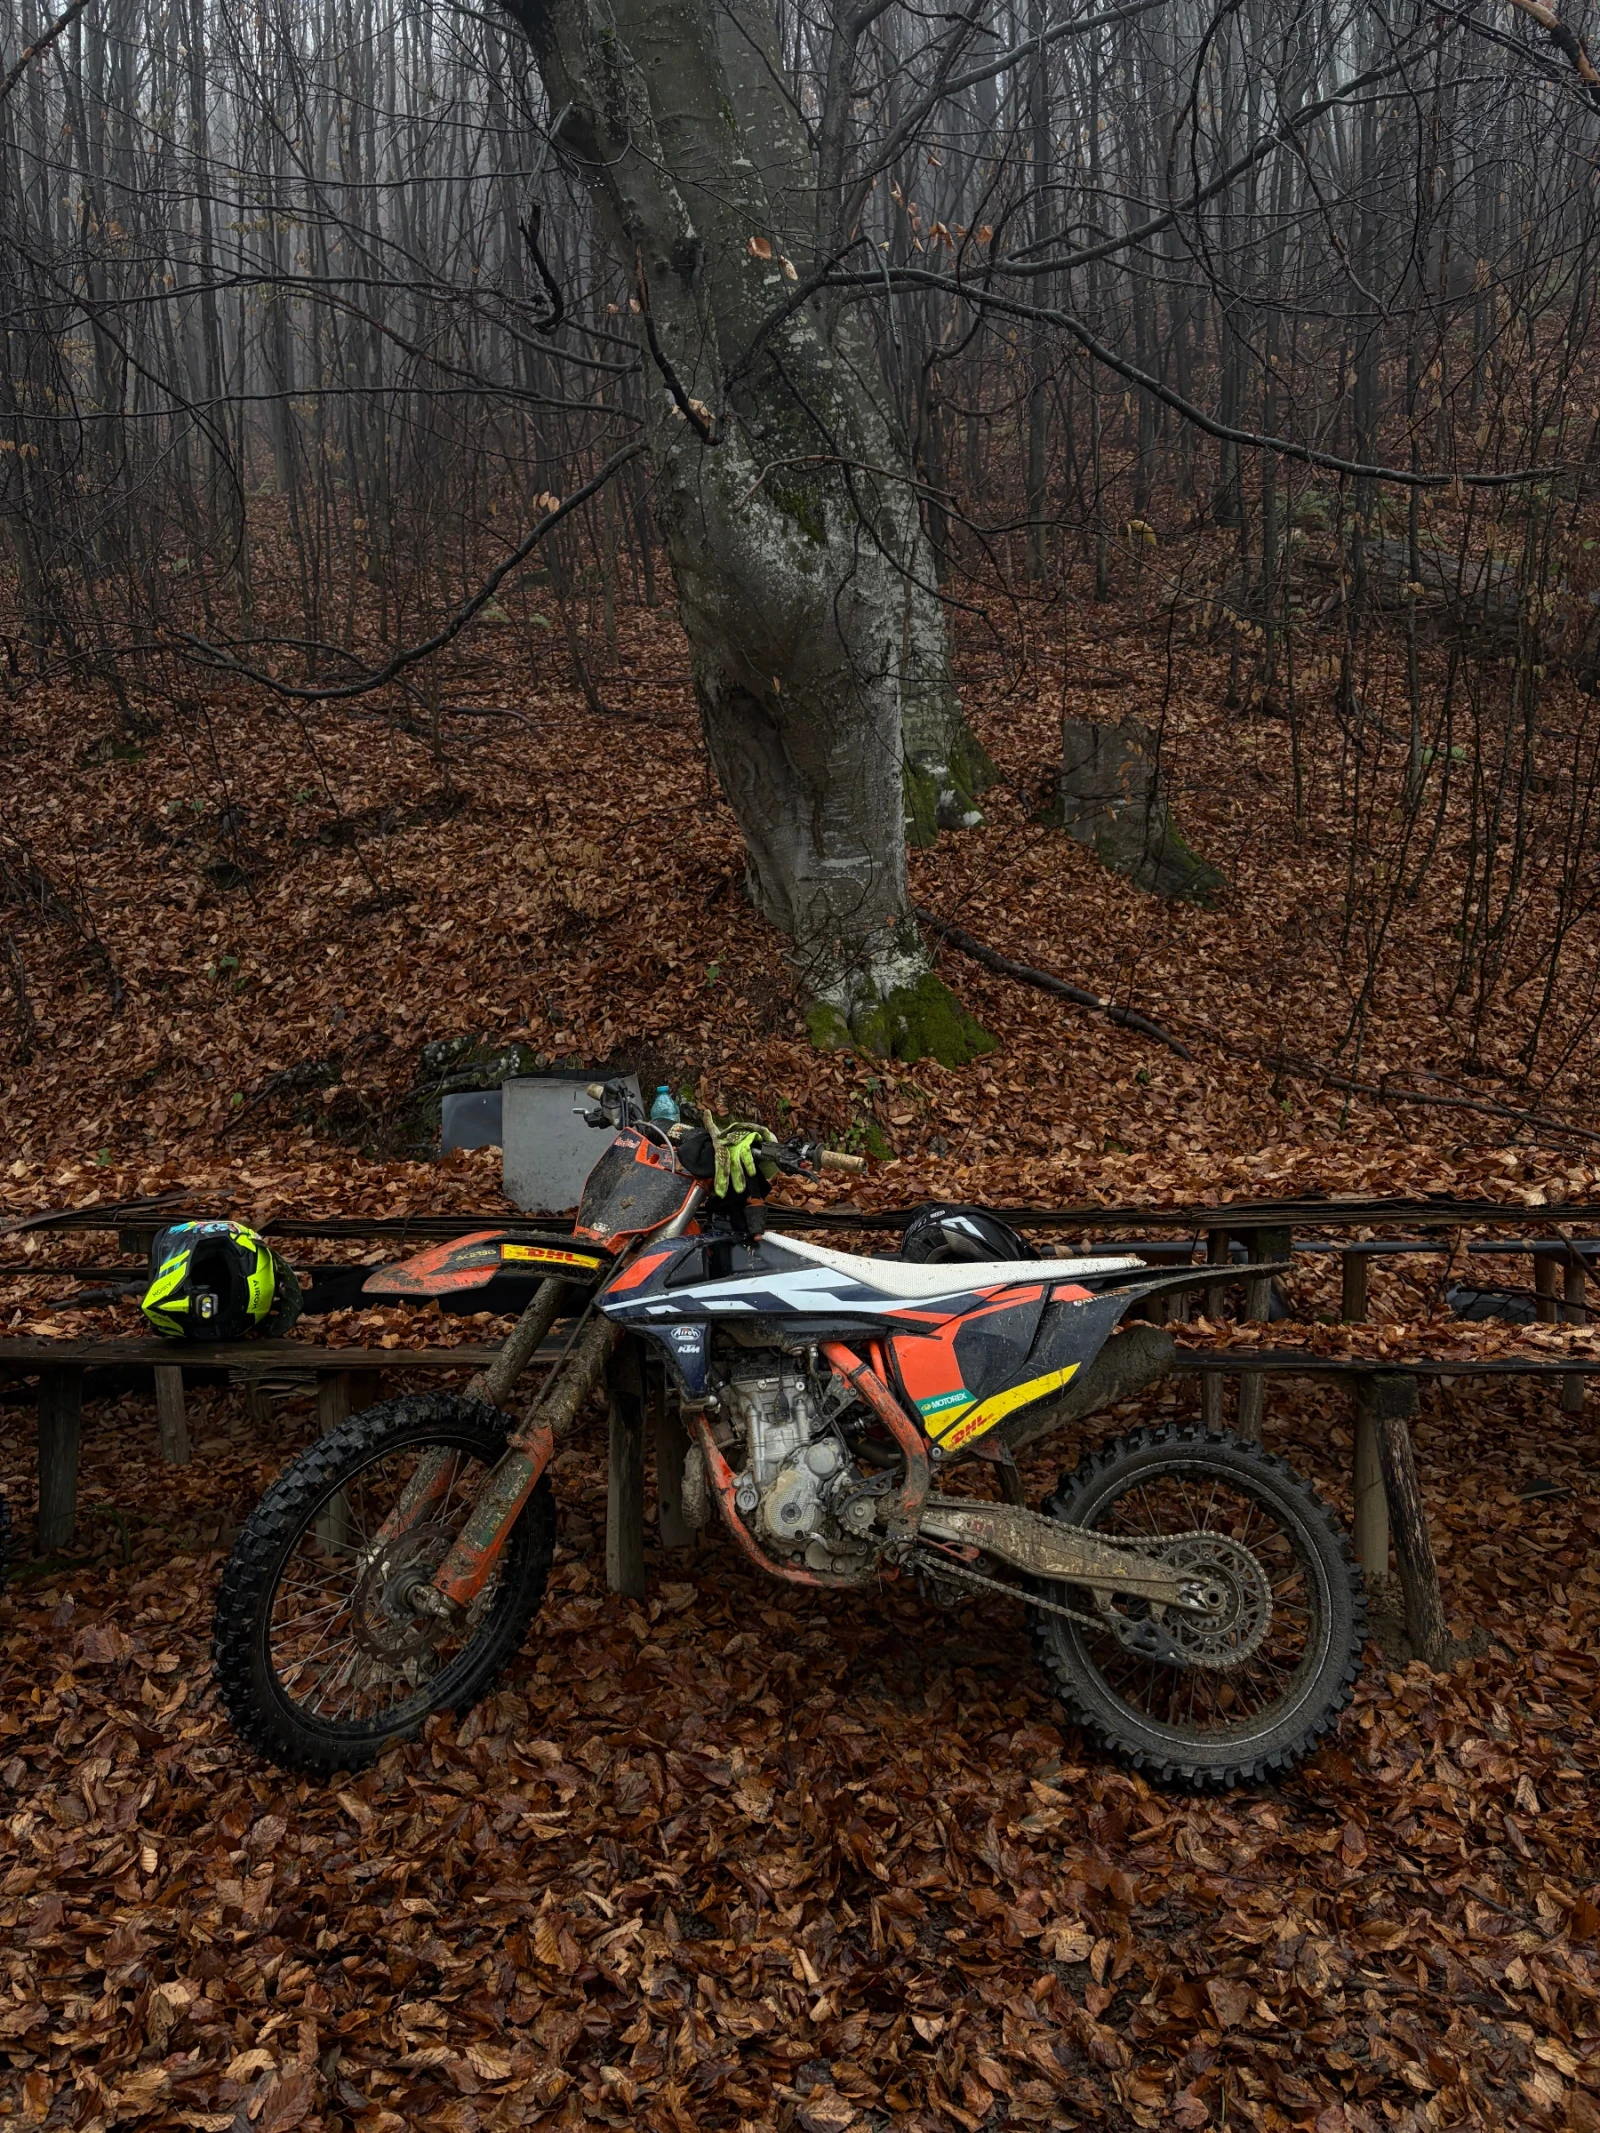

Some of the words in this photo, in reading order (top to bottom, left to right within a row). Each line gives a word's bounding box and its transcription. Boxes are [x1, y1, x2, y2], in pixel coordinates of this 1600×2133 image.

[524, 1247, 580, 1263] DHL
[253, 1279, 261, 1310] AIROH
[677, 1344, 701, 1354] KTM
[930, 1392, 968, 1409] MOTOREX
[951, 1414, 989, 1445] DHL
